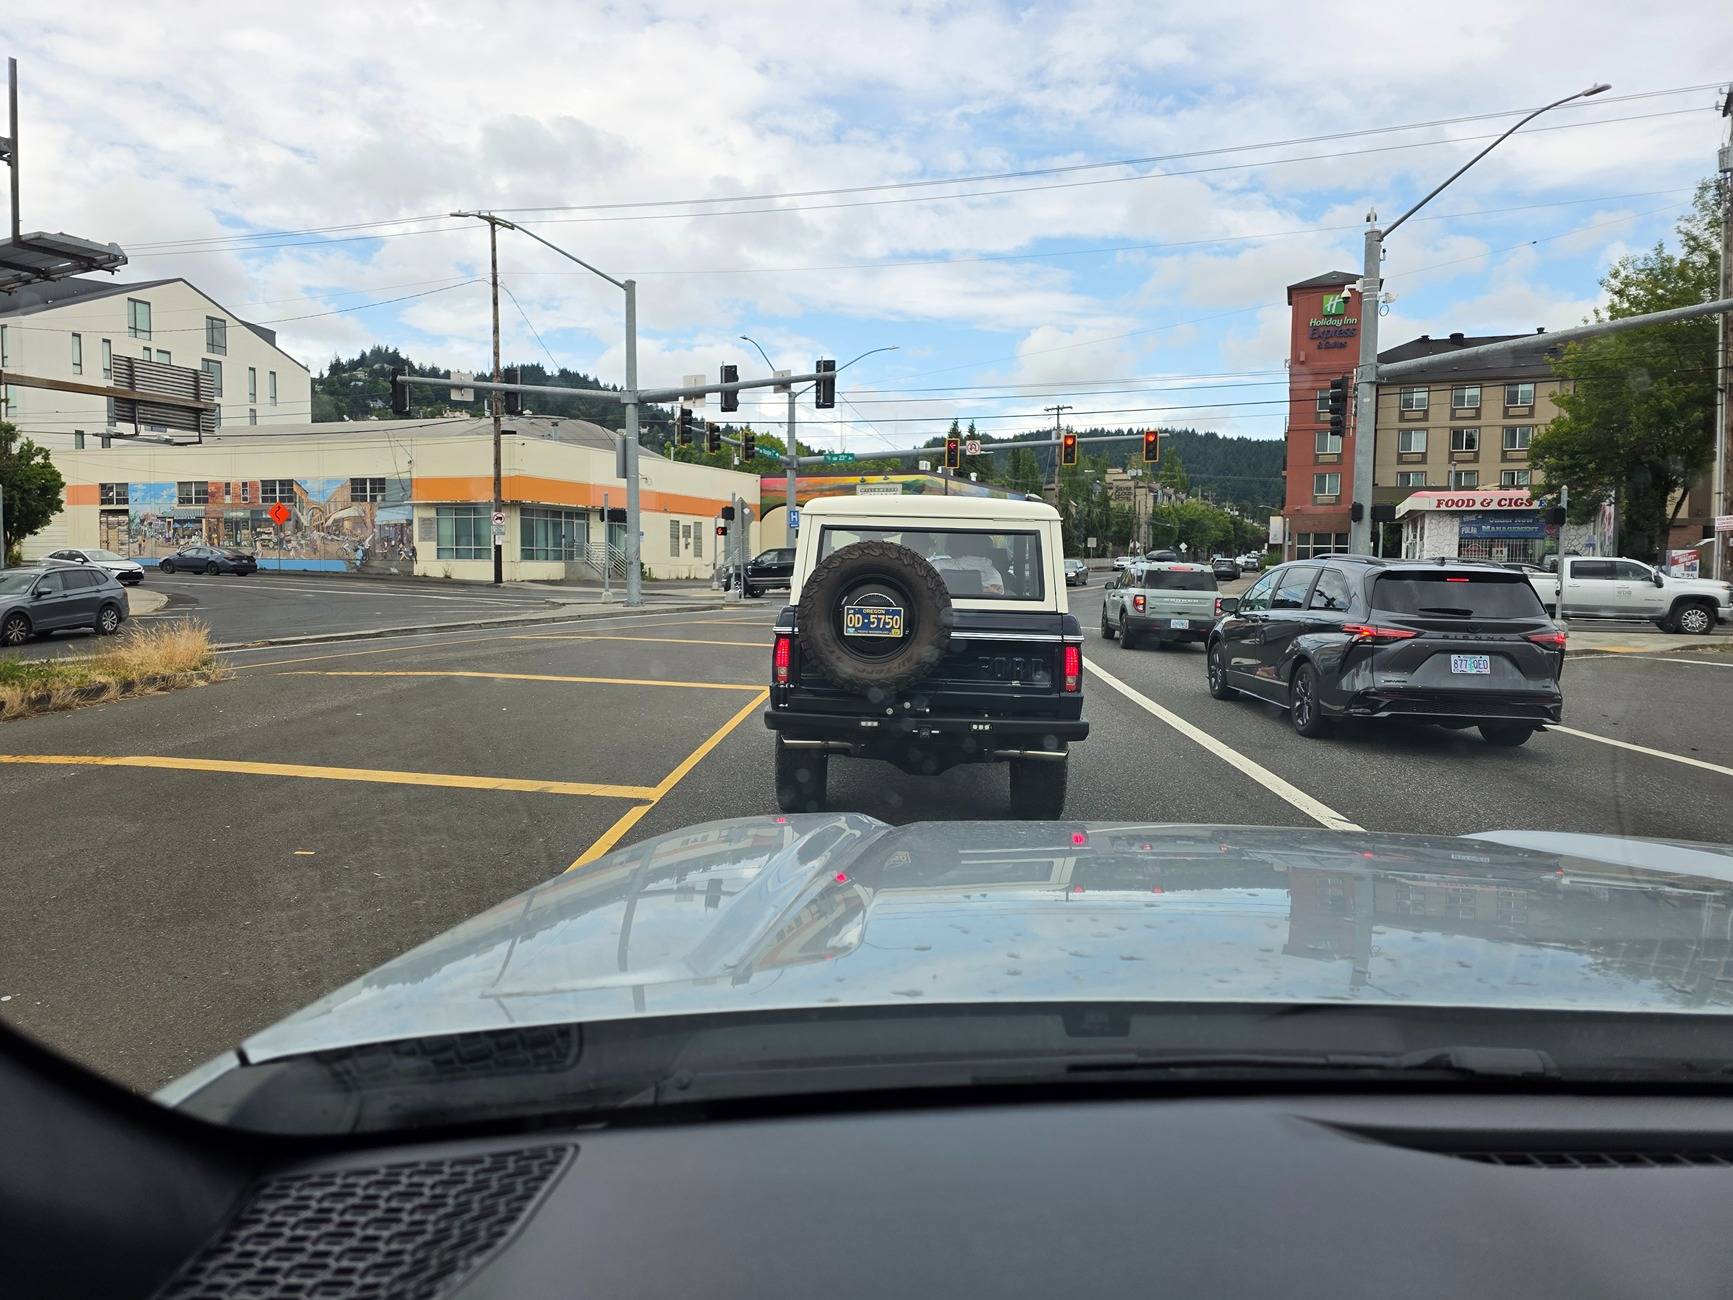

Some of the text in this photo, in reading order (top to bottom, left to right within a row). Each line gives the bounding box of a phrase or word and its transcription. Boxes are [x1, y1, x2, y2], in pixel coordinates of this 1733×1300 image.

[1309, 316, 1358, 327] Holiday Inn
[1309, 326, 1356, 340] Express
[1436, 498, 1476, 509] FOOD
[1480, 498, 1493, 508] &
[1497, 497, 1534, 508] CIGS
[791, 511, 798, 521] H
[1453, 659, 1468, 669] 877
